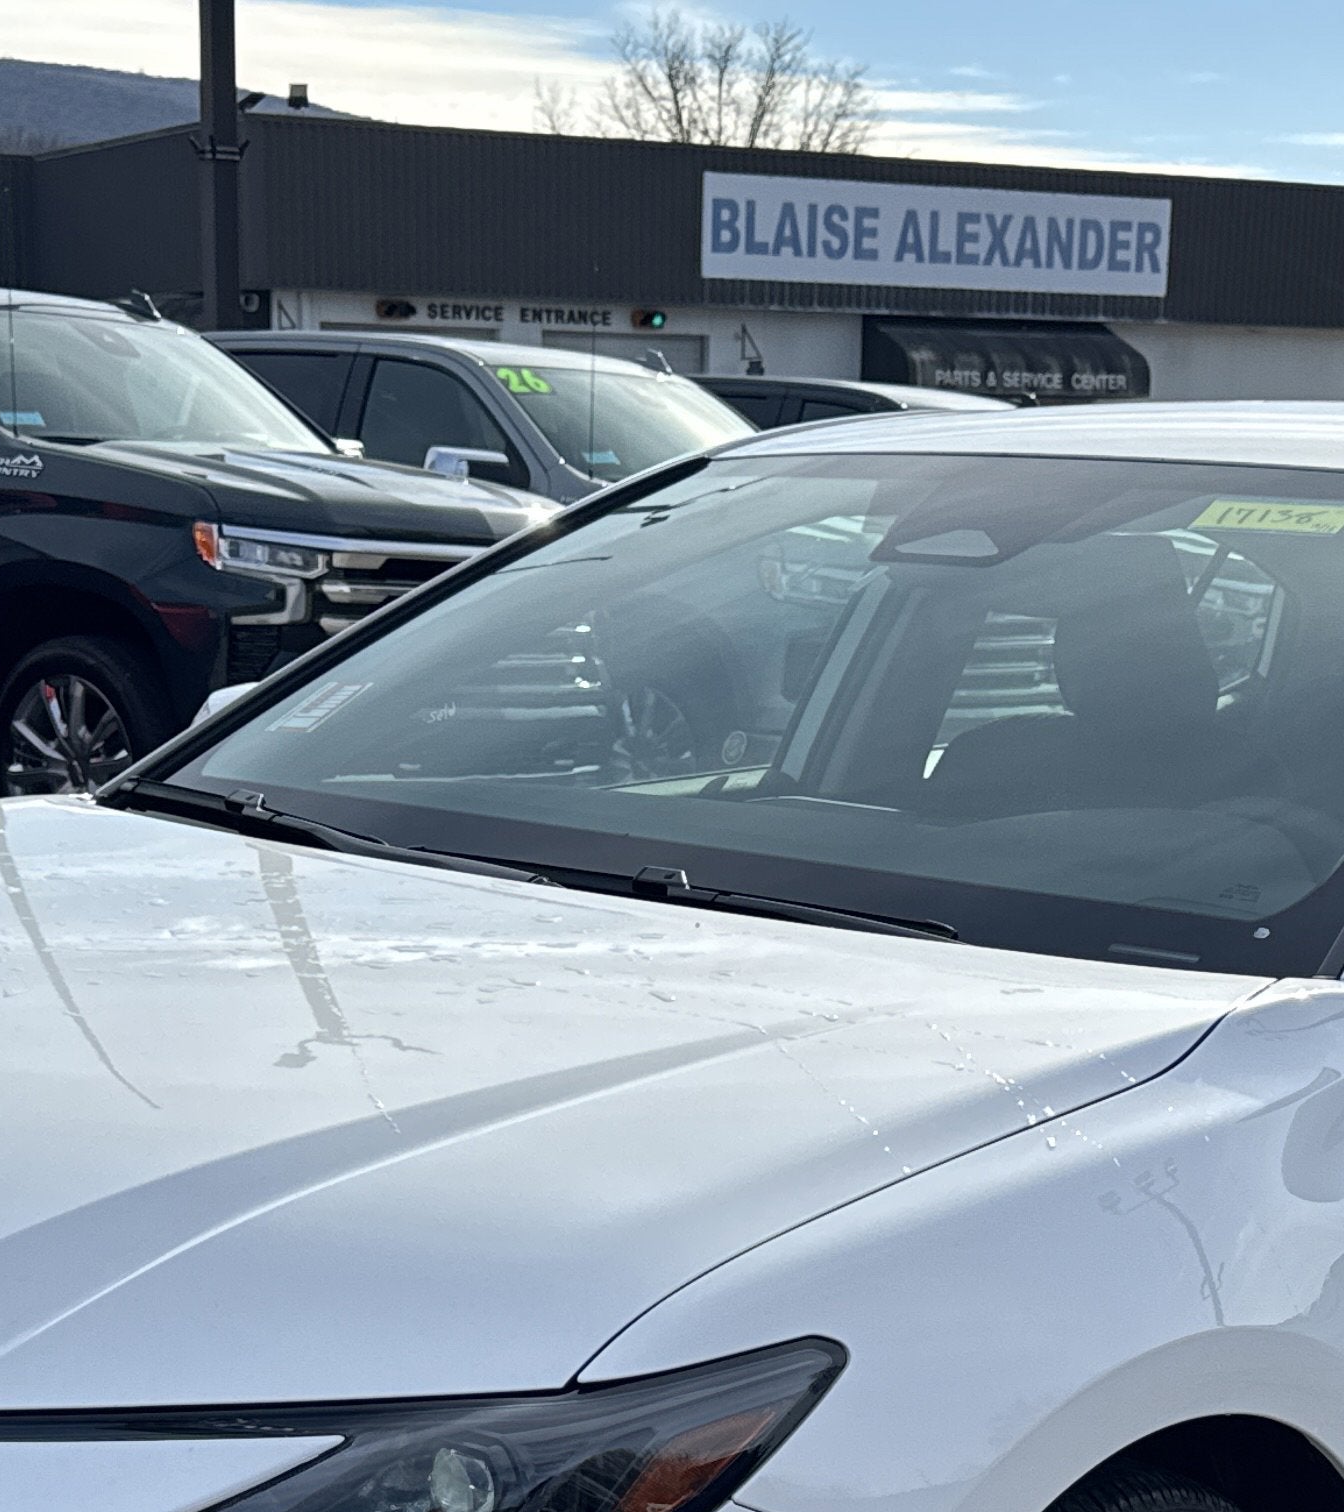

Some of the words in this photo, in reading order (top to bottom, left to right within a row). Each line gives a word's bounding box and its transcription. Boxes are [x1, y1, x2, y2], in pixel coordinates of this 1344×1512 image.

[710, 197, 880, 262] BLAISE
[894, 208, 1162, 274] ALEXANDER
[427, 303, 504, 322] SERVICE
[519, 307, 611, 326] ENTRANCE
[496, 367, 552, 393] 26
[935, 369, 981, 388] PARTS
[986, 371, 997, 387] &
[1003, 371, 1063, 389] SERVICE
[1071, 374, 1127, 390] CENTER
